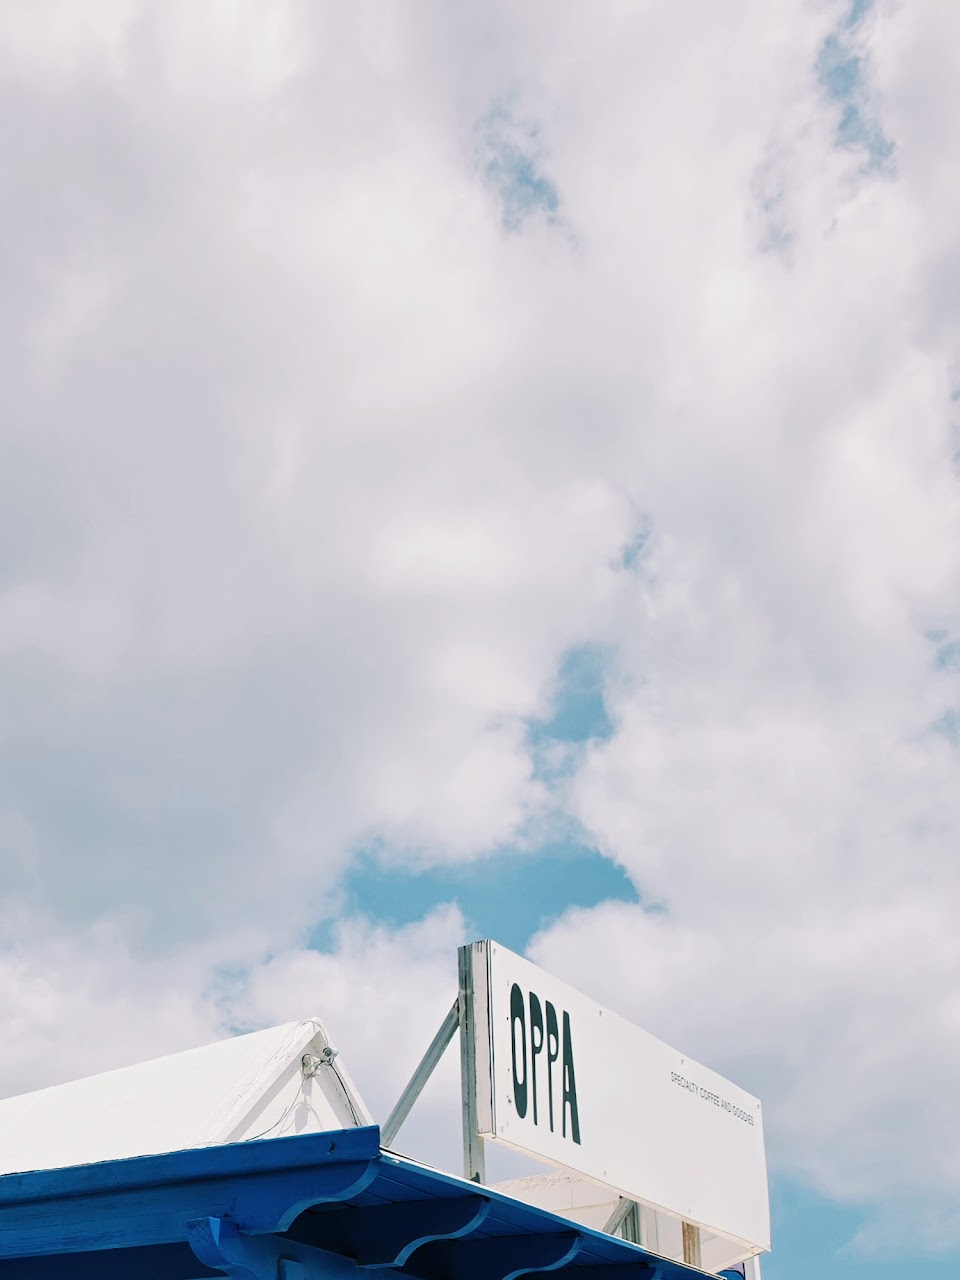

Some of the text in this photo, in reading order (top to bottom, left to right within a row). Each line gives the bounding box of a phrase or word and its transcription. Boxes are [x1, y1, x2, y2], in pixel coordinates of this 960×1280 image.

[510, 983, 581, 1146] OPPA
[670, 1071, 755, 1127] SPECIALTY COFFEE AND GOODIES
